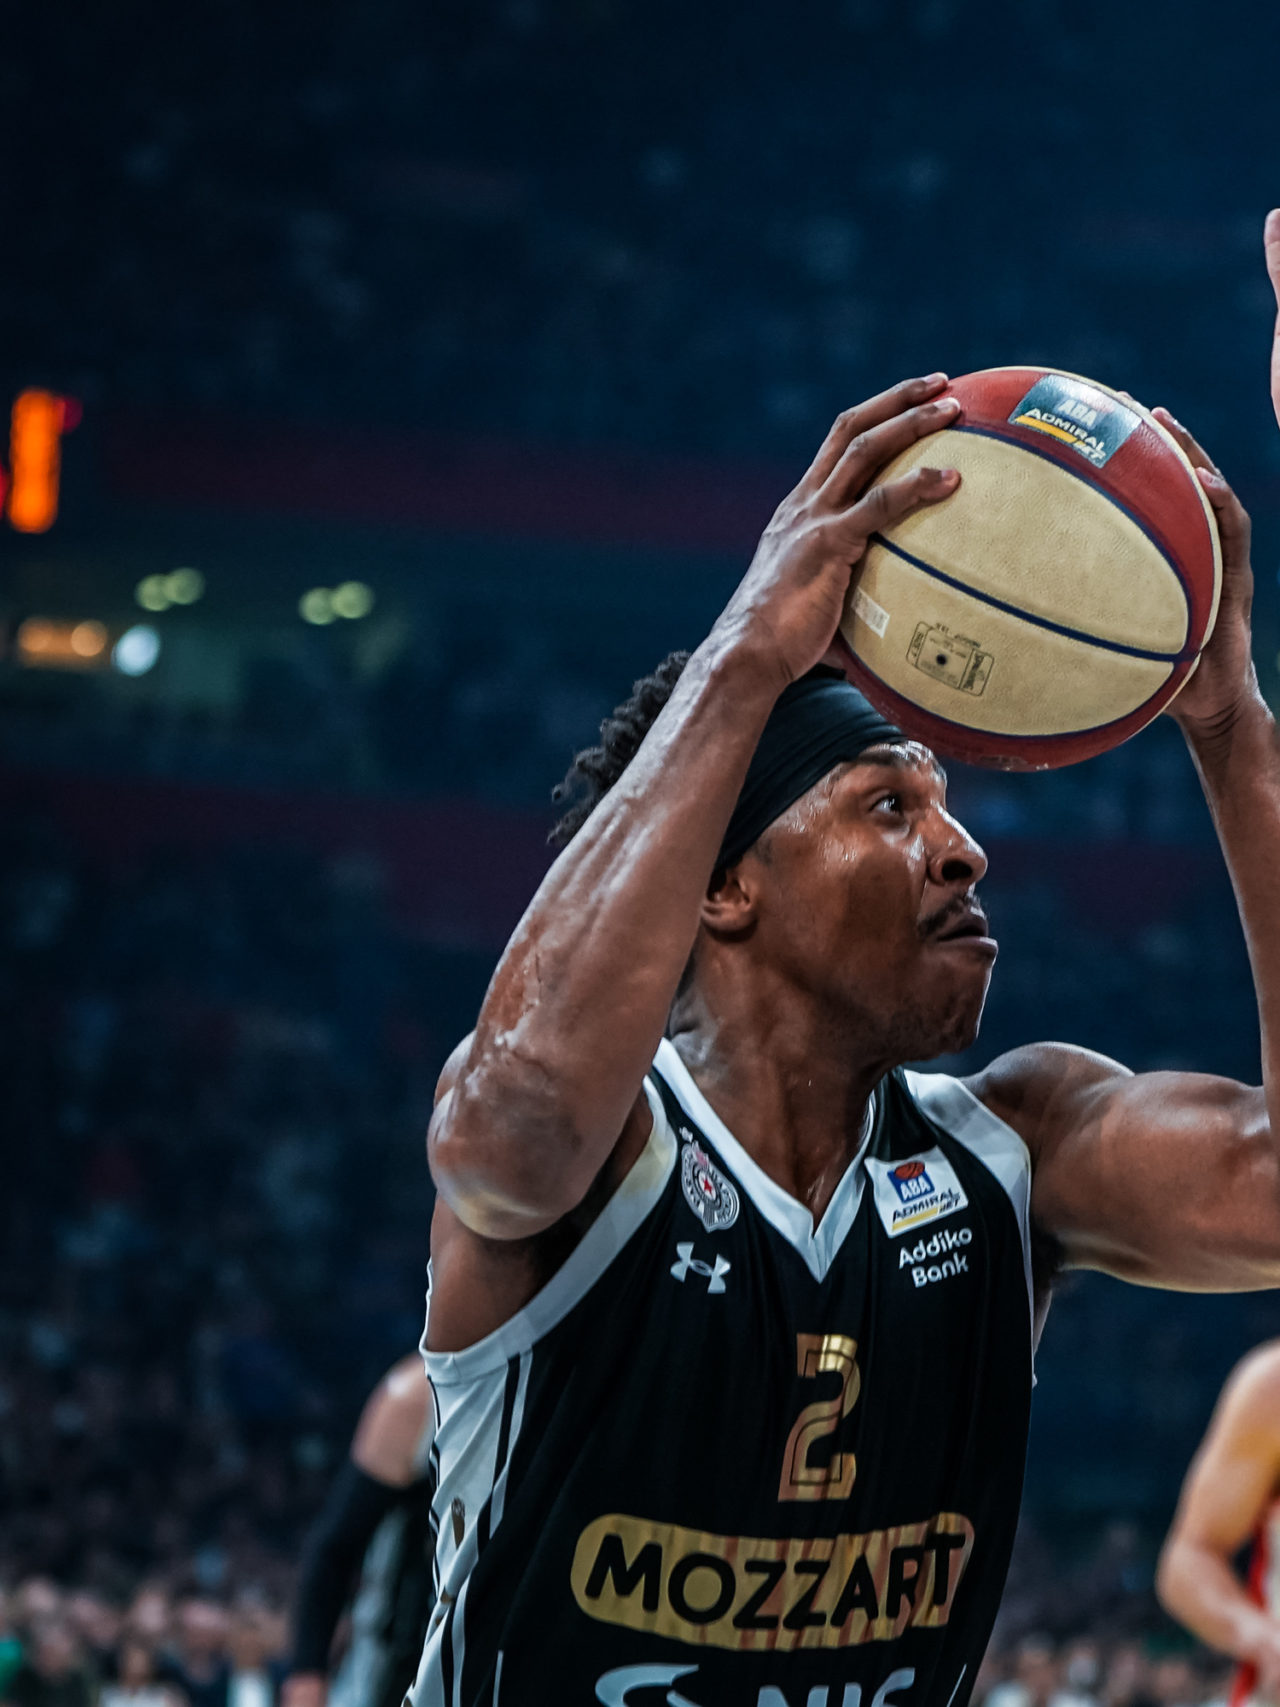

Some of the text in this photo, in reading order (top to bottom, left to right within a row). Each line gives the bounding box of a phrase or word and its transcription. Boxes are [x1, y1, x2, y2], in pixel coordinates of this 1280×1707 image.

[1023, 407, 1105, 451] ADMIRAL
[892, 1188, 957, 1223] ADMIRAL
[899, 1175, 931, 1200] ABA
[898, 1227, 973, 1269] Addiko
[911, 1251, 969, 1289] Bank
[777, 1332, 861, 1503] 2
[584, 1532, 966, 1630] MOZZART
